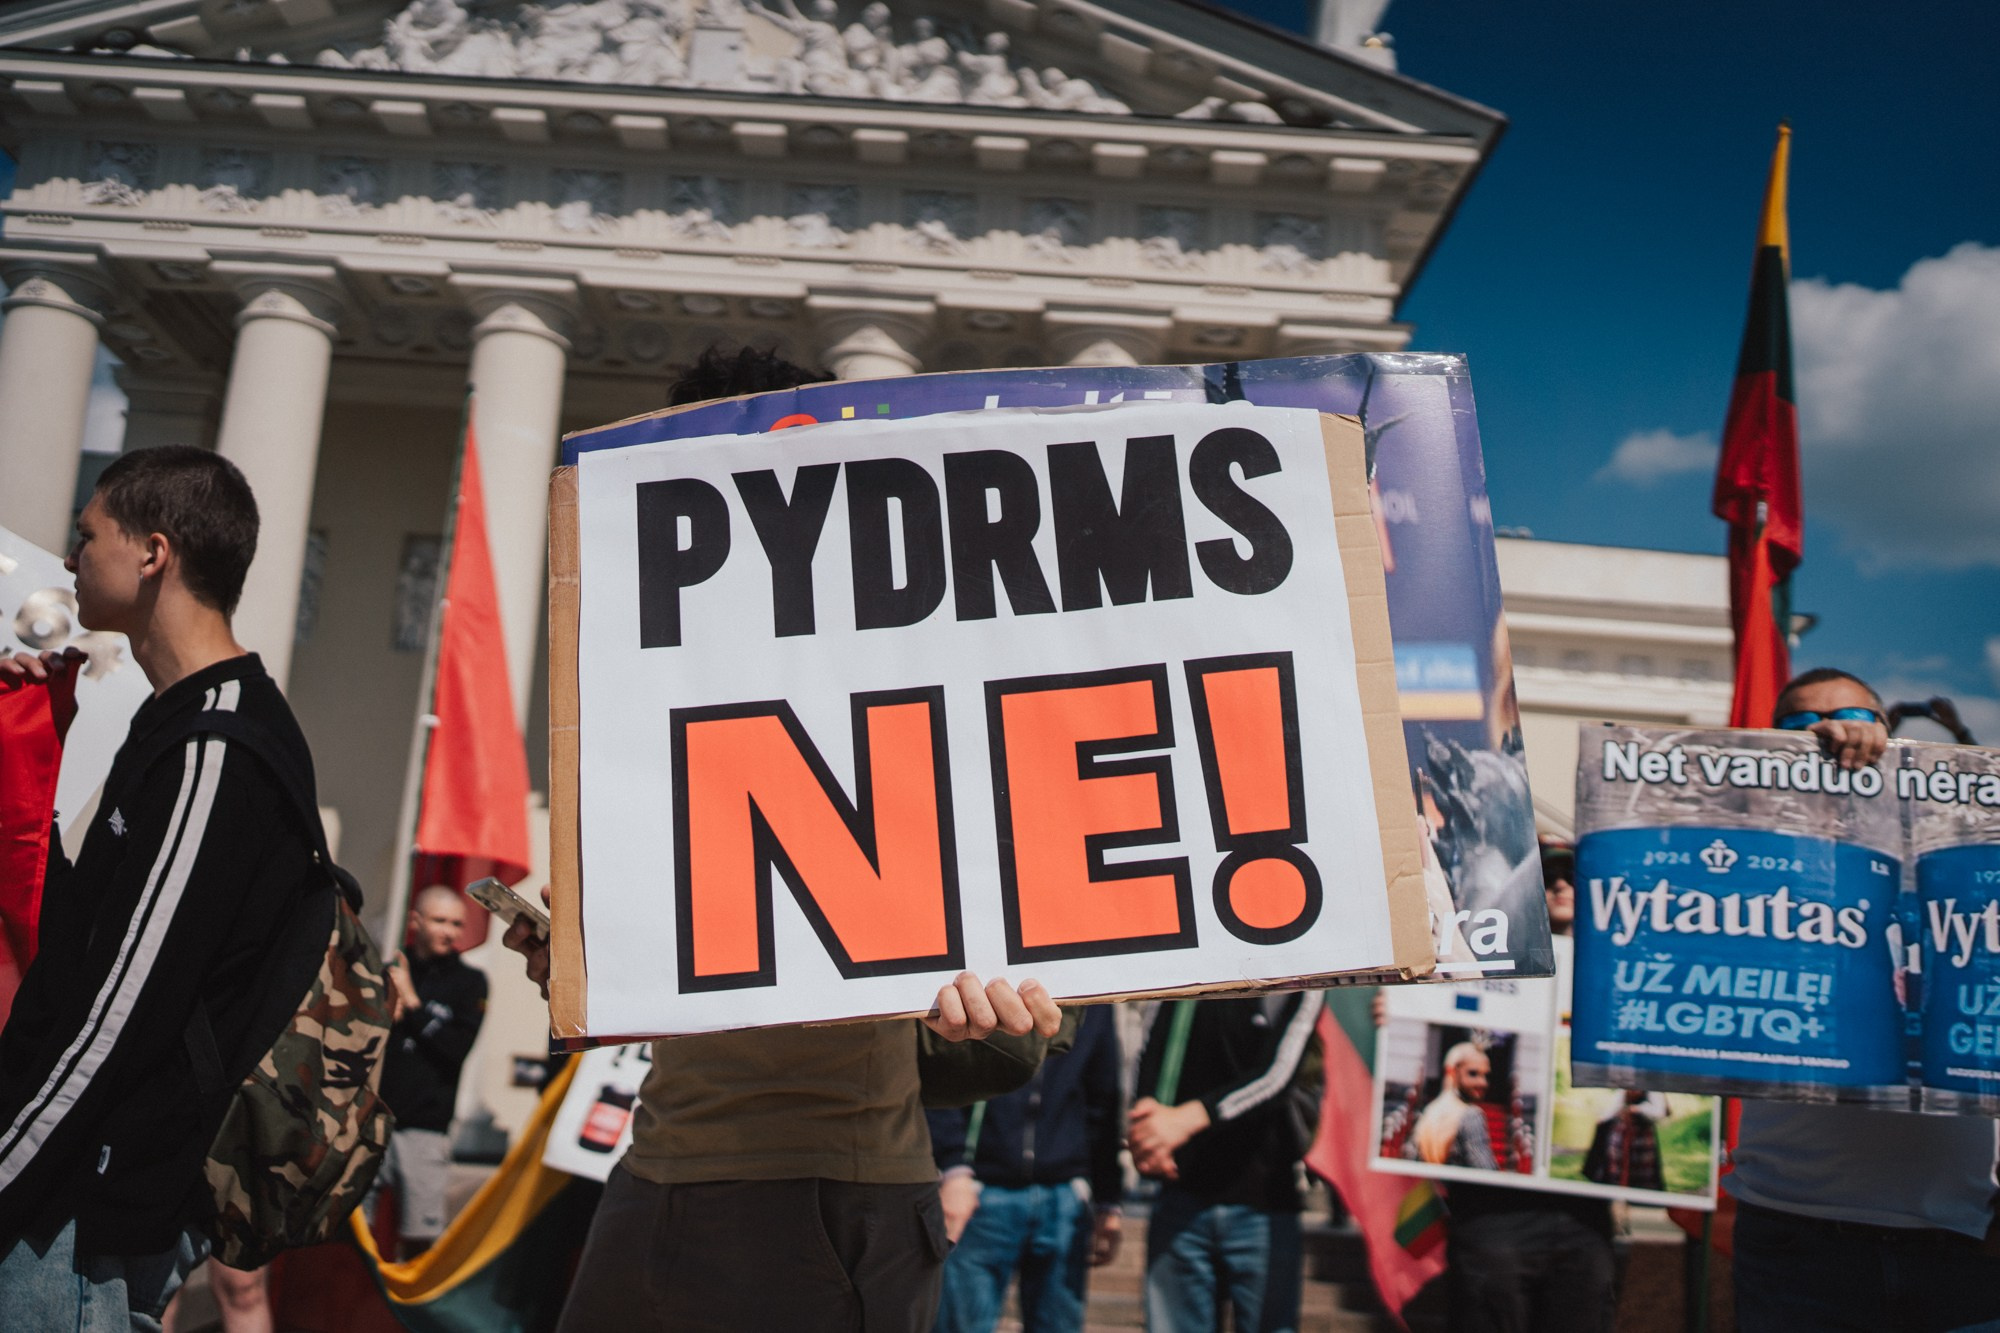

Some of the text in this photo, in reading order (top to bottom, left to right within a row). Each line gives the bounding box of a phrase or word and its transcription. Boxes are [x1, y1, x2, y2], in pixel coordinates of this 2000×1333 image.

[636, 427, 1294, 649] PYDRMS
[1603, 741, 2000, 806] Net vanduo nėra
[669, 651, 1323, 995] NE!
[1747, 855, 1804, 873] 2024
[1430, 908, 1509, 956] ra
[1589, 876, 1868, 949] Vytautas
[1927, 898, 2000, 968] Vyt
[1614, 952, 1832, 1012] UŽ MEILĘ!
[1617, 998, 1826, 1044] #LGBTQ+
[1949, 1022, 2000, 1057] GE
